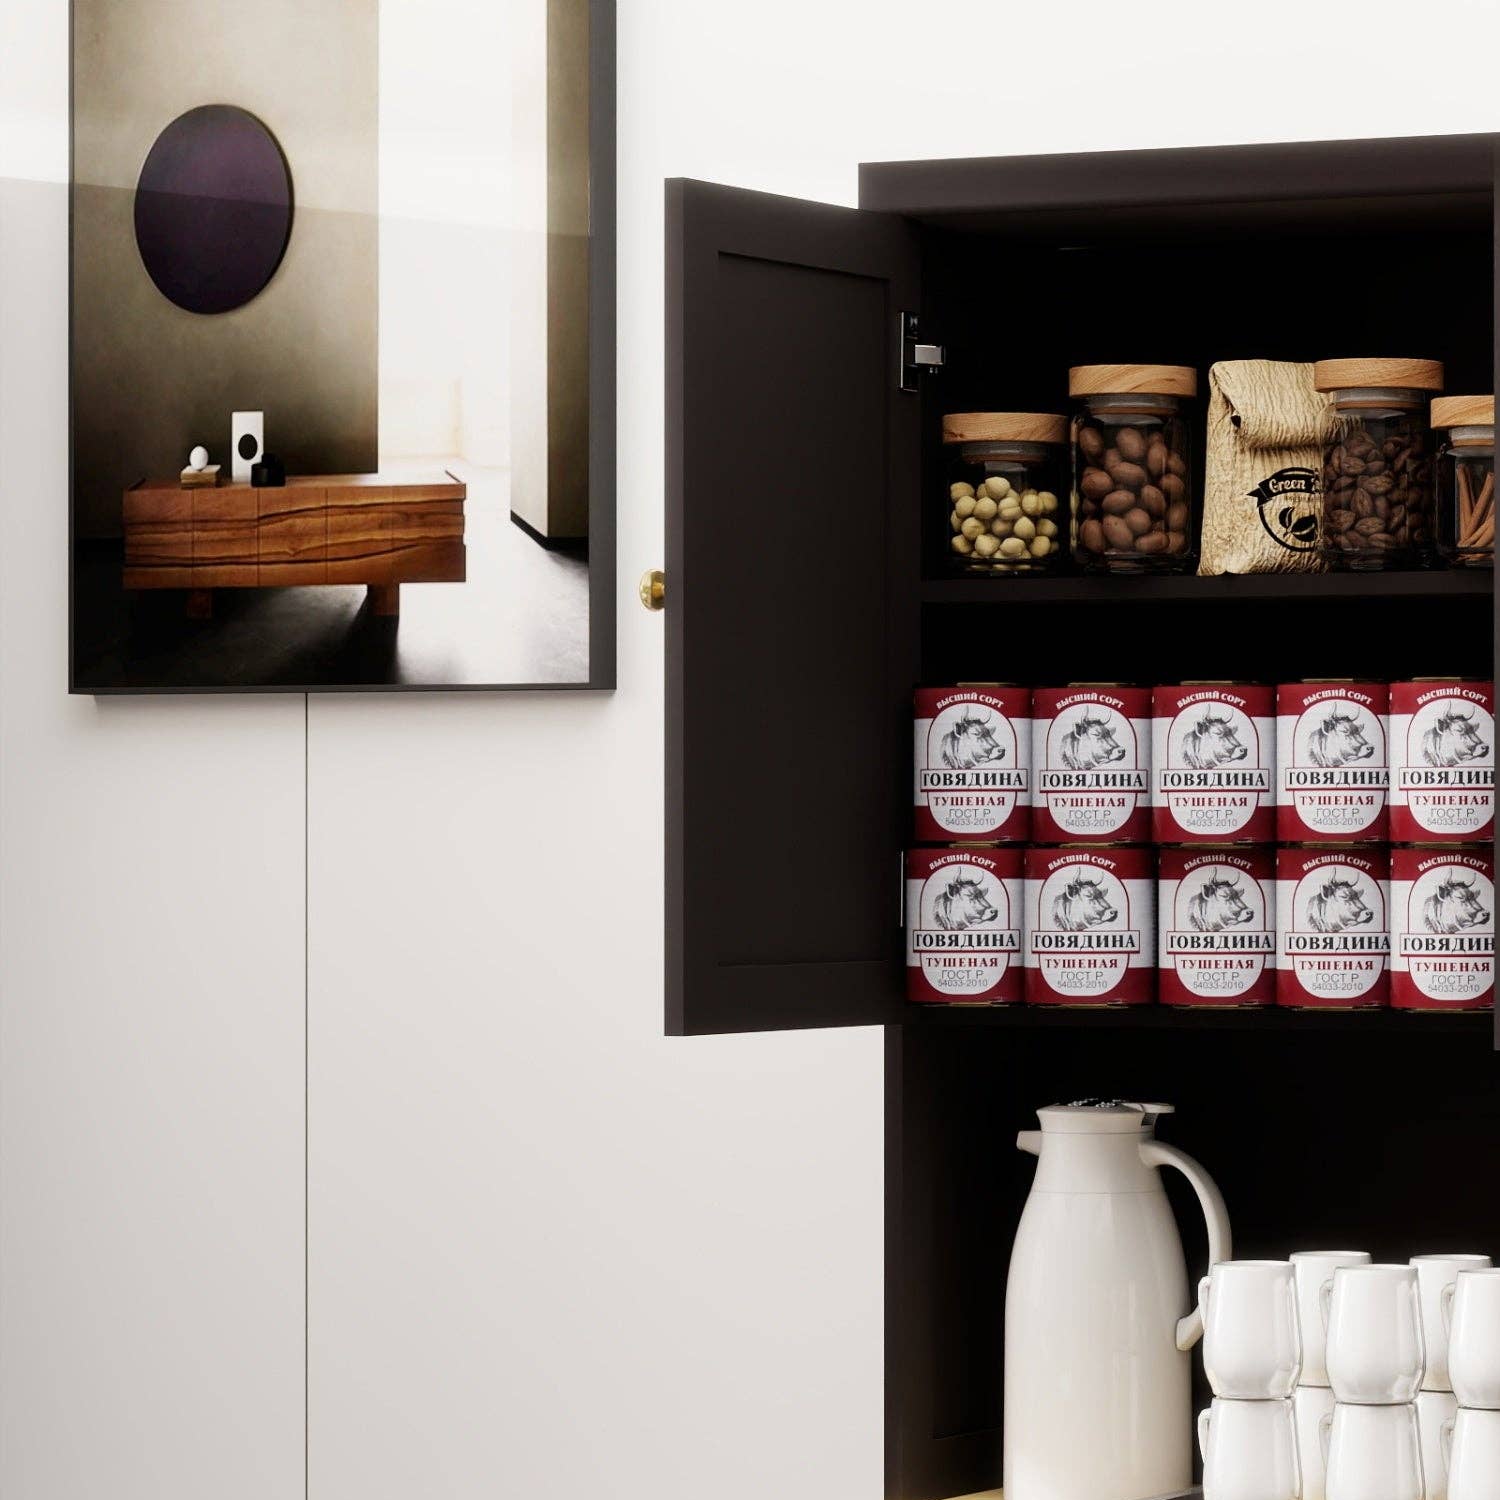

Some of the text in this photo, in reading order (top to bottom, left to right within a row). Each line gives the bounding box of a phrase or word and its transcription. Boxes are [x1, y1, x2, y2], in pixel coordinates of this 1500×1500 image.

[1268, 478, 1306, 493] Green
[936, 692, 1004, 709] ВЫСШИЙ СОРТ
[1056, 692, 1124, 709] ВЫСШИЙ СОРТ
[1177, 690, 1246, 708] ВЫСШИЙ СОРТ
[1303, 688, 1373, 706] ВЫСШИЙ СОРТ
[1417, 687, 1488, 704] ВЫСШИЙ СОРТ
[923, 772, 1023, 787] ГОВЯДИНА
[1042, 773, 1143, 788] ГОВЯДИНА
[1163, 772, 1266, 787] ГОВЯДИНА
[1289, 770, 1390, 786] ГОВЯДИНА
[1403, 770, 1495, 786] ГОВЯДИН
[933, 796, 1005, 806] ТУШЕНАЯ
[1053, 797, 1125, 807] ТУШЕНАЯ
[1174, 797, 1247, 807] ТУШЕНАЯ
[1300, 795, 1374, 805] ТУШЕНАЯ
[1413, 795, 1489, 805] ТУШЕНАЯ
[948, 808, 979, 819] ГОСТ
[1068, 809, 1099, 820] ГОСТ
[1189, 809, 1221, 820] ГОСТ
[1315, 807, 1347, 819] ГОСТ
[1429, 807, 1462, 819] ГОСТ
[929, 853, 997, 870] ВЫСШИЙ СОРТ
[1048, 853, 1116, 870] ВЫСШИЙ СОРТ
[1183, 853, 1253, 871] ВЫСШИЙ СОРТ
[1302, 854, 1372, 871] ВЫСШИЙ СОРТ
[1418, 854, 1489, 871] ВЫСШИЙ СОРТ
[916, 933, 1016, 948] ГОВЯДИНА
[1034, 934, 1136, 949] ГОВЯДИНА
[1170, 935, 1272, 950] ГОВЯДИНА
[1289, 936, 1390, 951] ГОВЯДИНА
[1404, 937, 1495, 952] ГОВЯДИН
[926, 957, 998, 967] ТУШЕНАЯ
[1045, 958, 1117, 968] ТУШЕНАЯ
[1180, 959, 1254, 969] ТУШЕНАЯ
[1299, 960, 1373, 970] ТУШЕНАЯ
[1414, 962, 1490, 972] ТУШЕНАЯ
[941, 969, 972, 980] ГОСТ
[1060, 970, 1091, 982] ГОСТ
[1196, 971, 1227, 982] ГОСТ
[1314, 972, 1346, 984] ГОСТ
[1430, 974, 1463, 985] ГОСТ
